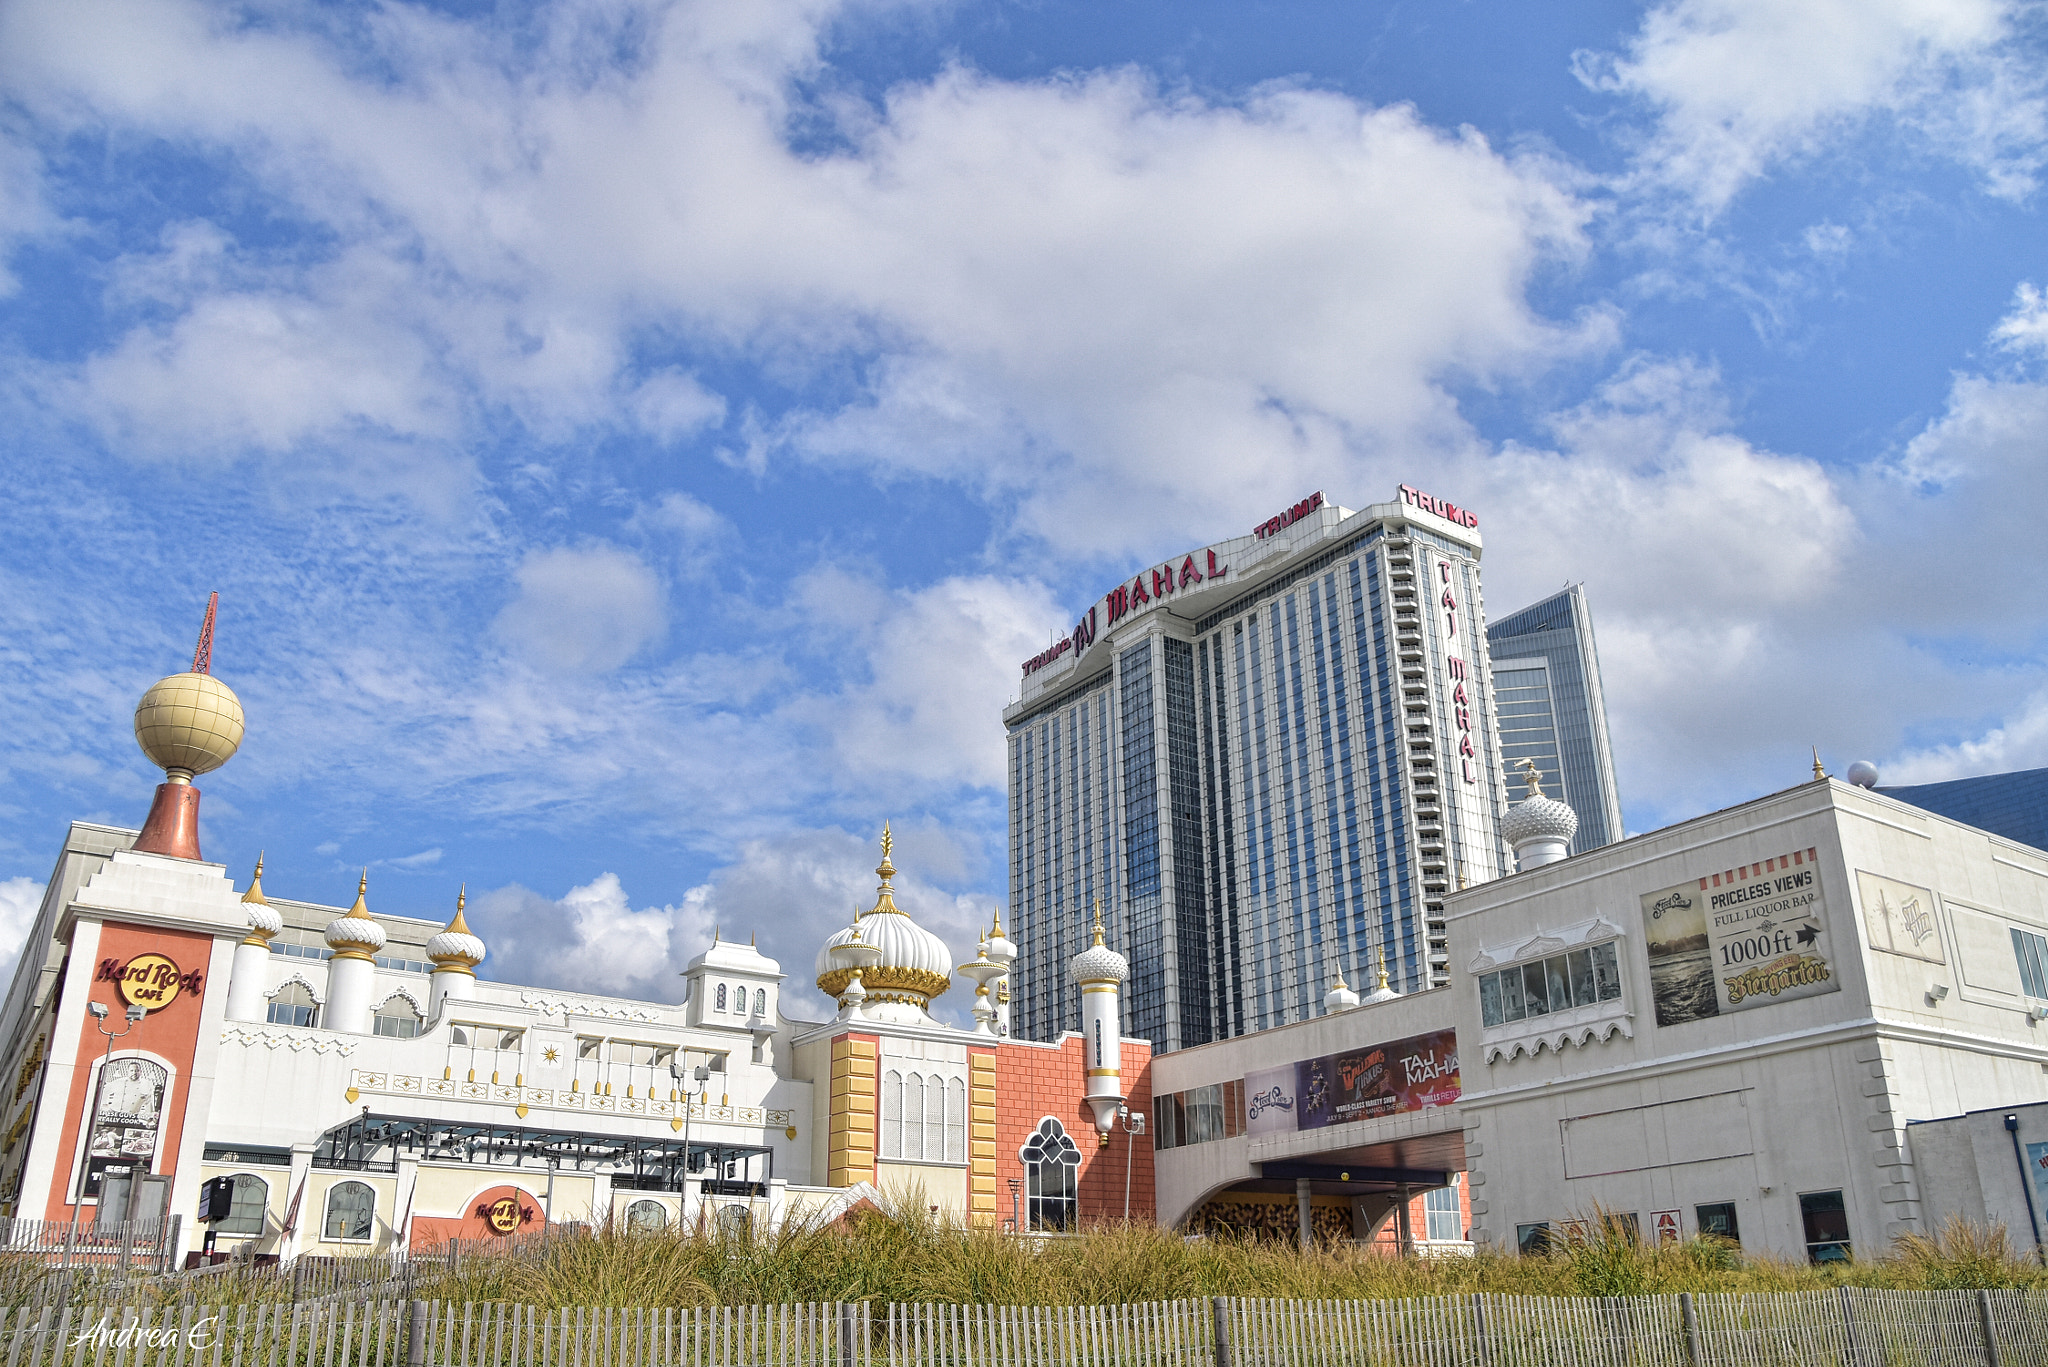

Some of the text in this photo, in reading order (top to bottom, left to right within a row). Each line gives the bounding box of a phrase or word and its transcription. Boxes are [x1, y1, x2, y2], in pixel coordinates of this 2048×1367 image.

[1254, 490, 1324, 540] TRUMP
[1400, 484, 1478, 528] TRUMP
[1022, 548, 1229, 677] TRUMP TAJ MAHAL
[1438, 560, 1475, 784] TAJ MAHAL
[1711, 871, 1813, 910] PRICELESS VIEWS
[1714, 893, 1815, 927] FULL LIQUOR BAR
[1720, 929, 1793, 967] 1000 ft
[95, 958, 203, 994] Hard Rock
[134, 988, 163, 1001] CAFE
[1723, 961, 1830, 1004] Biergarten
[1399, 1049, 1435, 1072] TAJ
[1354, 1063, 1383, 1101] ZIRKUS
[1335, 1101, 1365, 1113] WORLD-CLASS
[1383, 1095, 1397, 1104] SHOW
[475, 1203, 507, 1219] Hard
